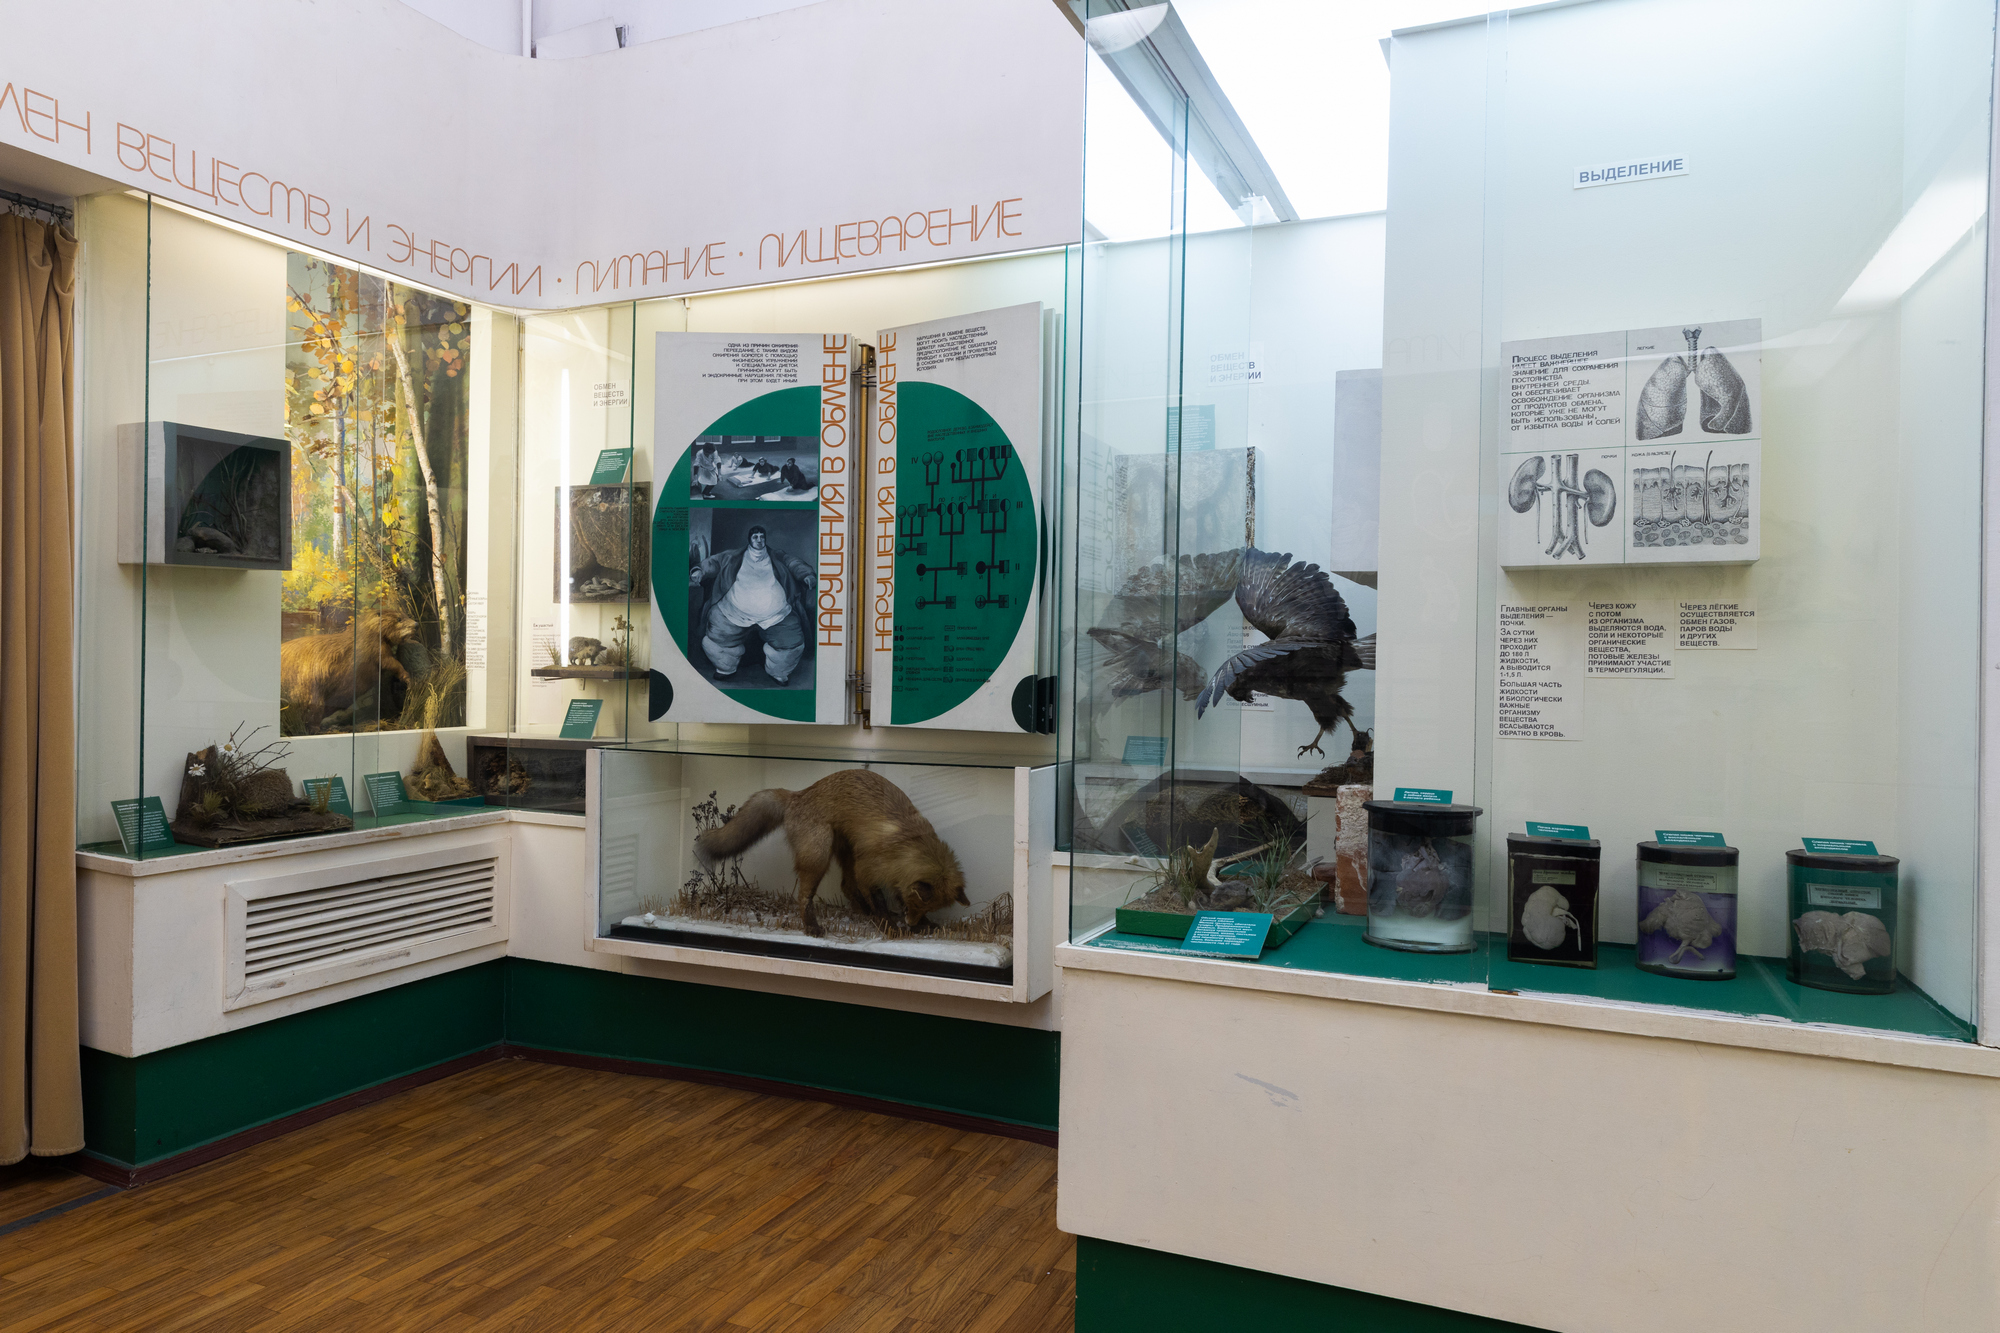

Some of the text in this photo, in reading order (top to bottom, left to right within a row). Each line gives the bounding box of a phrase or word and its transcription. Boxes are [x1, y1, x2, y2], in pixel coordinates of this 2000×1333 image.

[1579, 158, 1683, 183] ВЫДЕЛЕНИЕ
[116, 122, 332, 236] ВЕЩЕСТВ
[345, 207, 370, 252] И
[386, 223, 542, 297] ЭНЕРГИИ
[575, 197, 1023, 295] ПИТАНИЕ ПИЩЕВАРЕНИЕ
[1210, 352, 1244, 362] ОБМЕН
[1512, 350, 1598, 363] ПРОЦЕСС ВЫДЕЛЕНИЯ
[1211, 361, 1255, 372] ВЕЩЕСТВ
[1572, 363, 1618, 371] СОХРАНЕНИЯ
[1219, 371, 1261, 382] ЭНЕРГИИ
[1512, 375, 1563, 383] ПОСТОЯНСТВА
[1512, 381, 1558, 390] ВНУТРЕННЕЙ
[1525, 387, 1581, 396] ОБЕСПЕЧИВАЕТ
[1512, 391, 1620, 404] ОСВОБОЖДЕНИЕ ОРГАНИЗМА
[1524, 402, 1567, 410] ПРОДУКТОВ
[1524, 422, 1558, 430] ИЗБЫТКА
[1596, 417, 1620, 425] СОЛЕЙ
[818, 334, 847, 647] НАРУШЕНИЯ В ОБМЕНЕ
[874, 332, 897, 652] НАРУШЕНИЯ В ОБМЕНЕ
[1500, 679, 1537, 688] БОЛЬШАЯ
